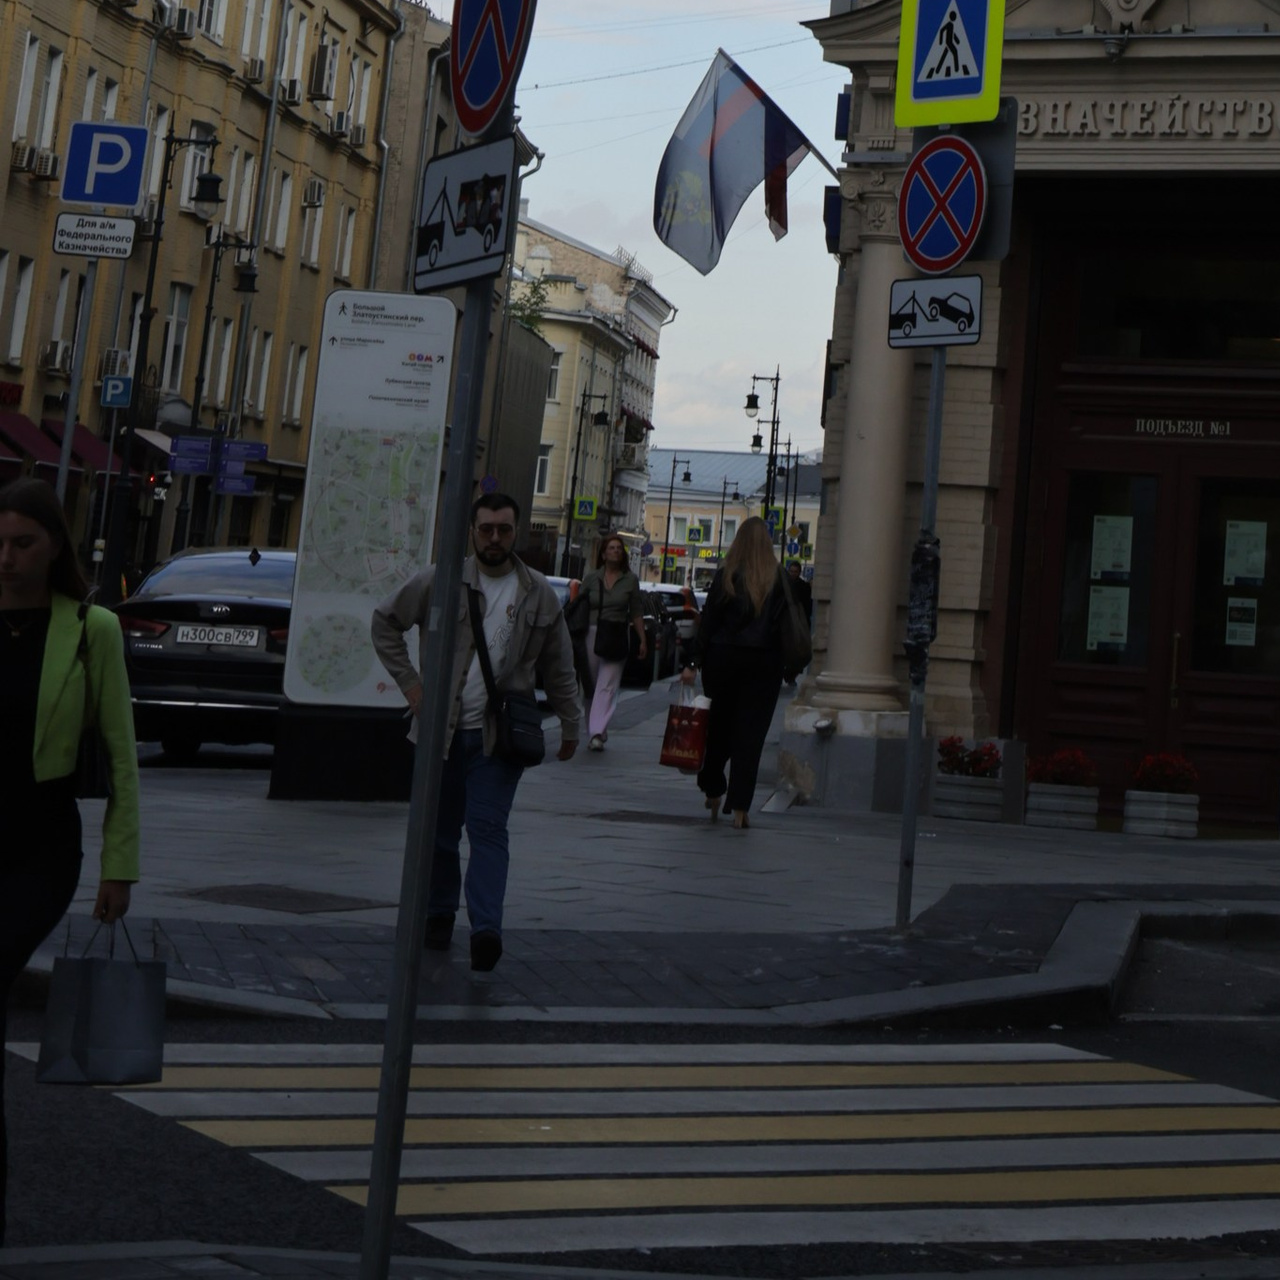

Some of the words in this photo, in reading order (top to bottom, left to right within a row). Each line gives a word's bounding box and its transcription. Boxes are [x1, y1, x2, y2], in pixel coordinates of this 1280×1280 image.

[84, 132, 132, 195] P
[76, 218, 97, 229] Для
[100, 221, 116, 230] а/м
[57, 229, 132, 244] Федерального
[57, 241, 128, 255] Казначейства
[106, 380, 124, 402] P
[1136, 418, 1205, 437] ПОДЪЕЗД
[1209, 421, 1231, 436] №1
